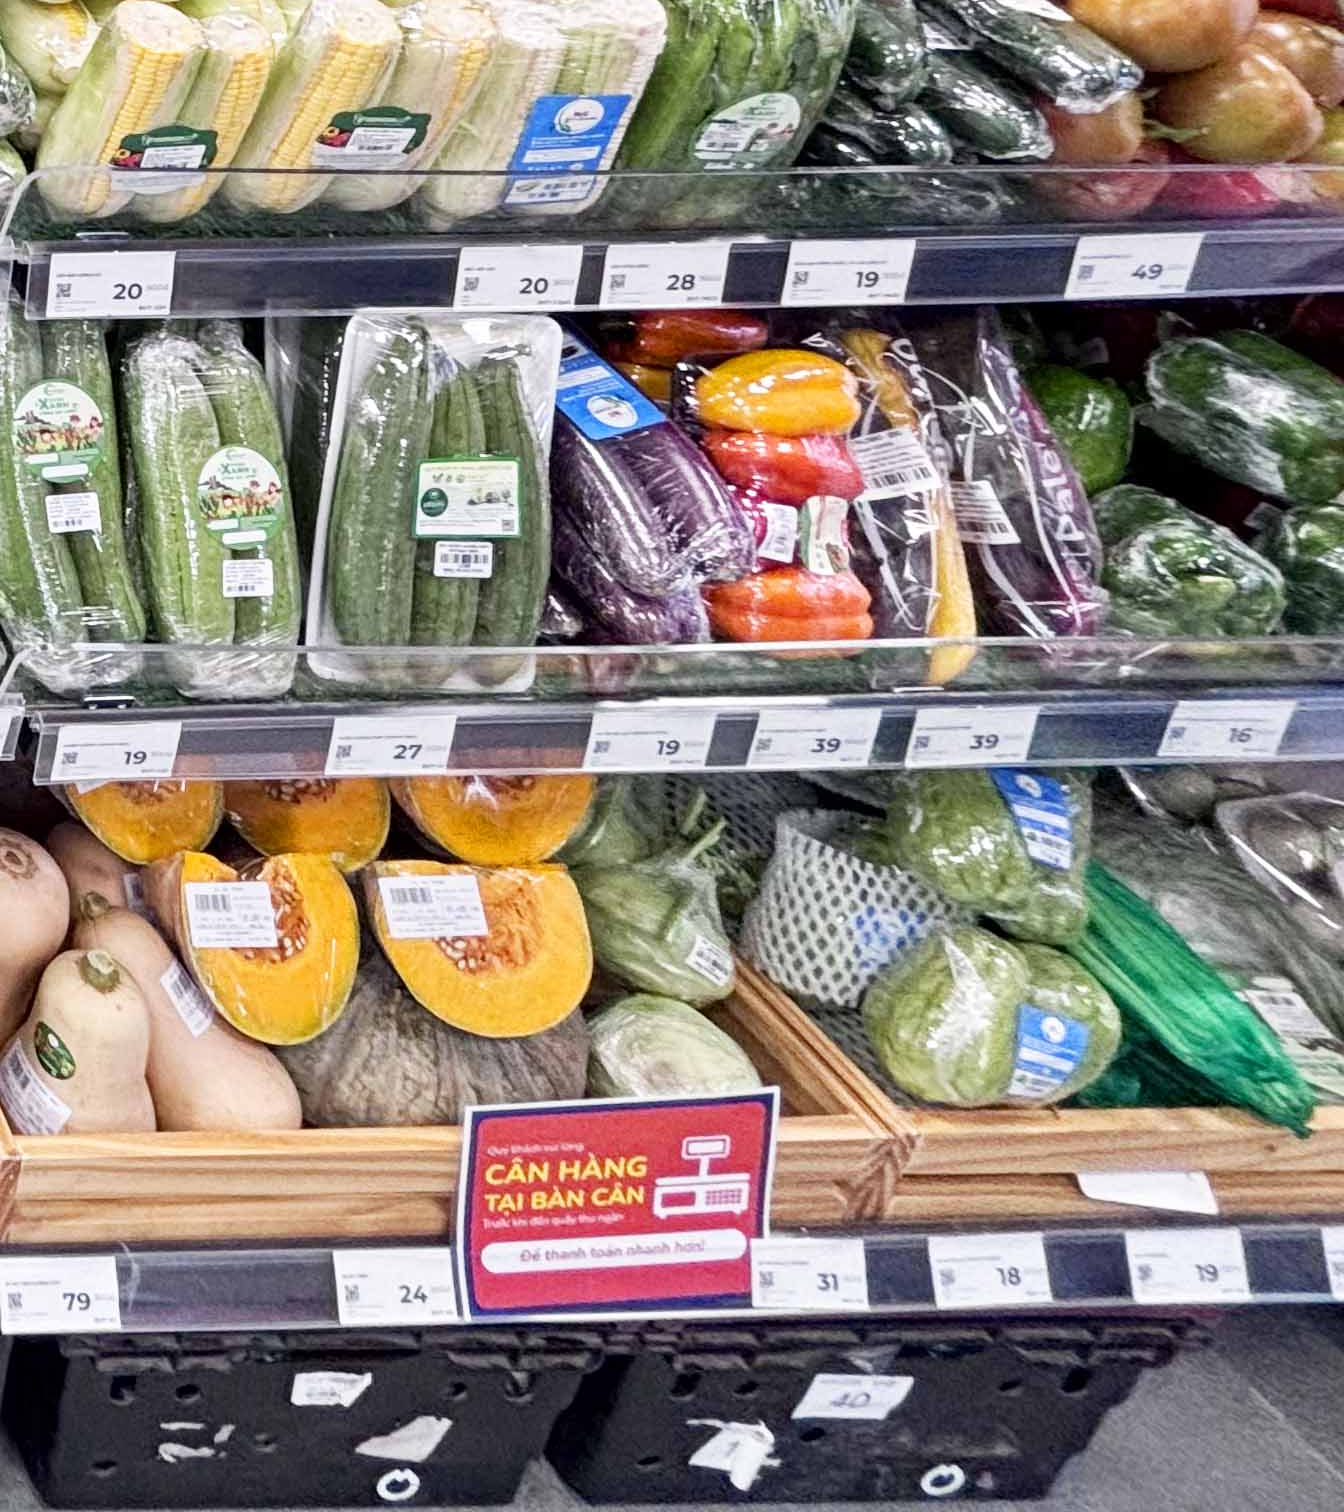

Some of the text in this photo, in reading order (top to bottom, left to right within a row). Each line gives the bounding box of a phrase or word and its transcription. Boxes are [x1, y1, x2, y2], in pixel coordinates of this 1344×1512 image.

[519, 277, 549, 295] 20
[666, 273, 696, 291] 28
[856, 271, 880, 288] 19
[113, 283, 143, 300] 20
[658, 739, 681, 756] 19
[811, 737, 841, 753] 39
[969, 734, 1000, 750] 39
[124, 751, 147, 765] 19
[393, 744, 423, 760] 27
[485, 1152, 649, 1186] CÂN HÀNG
[484, 1181, 645, 1217] TẠI BÀN CÂN
[817, 1273, 839, 1291] 31
[996, 1266, 1022, 1286] 18
[62, 1292, 91, 1311] 79
[399, 1285, 428, 1304] 24
